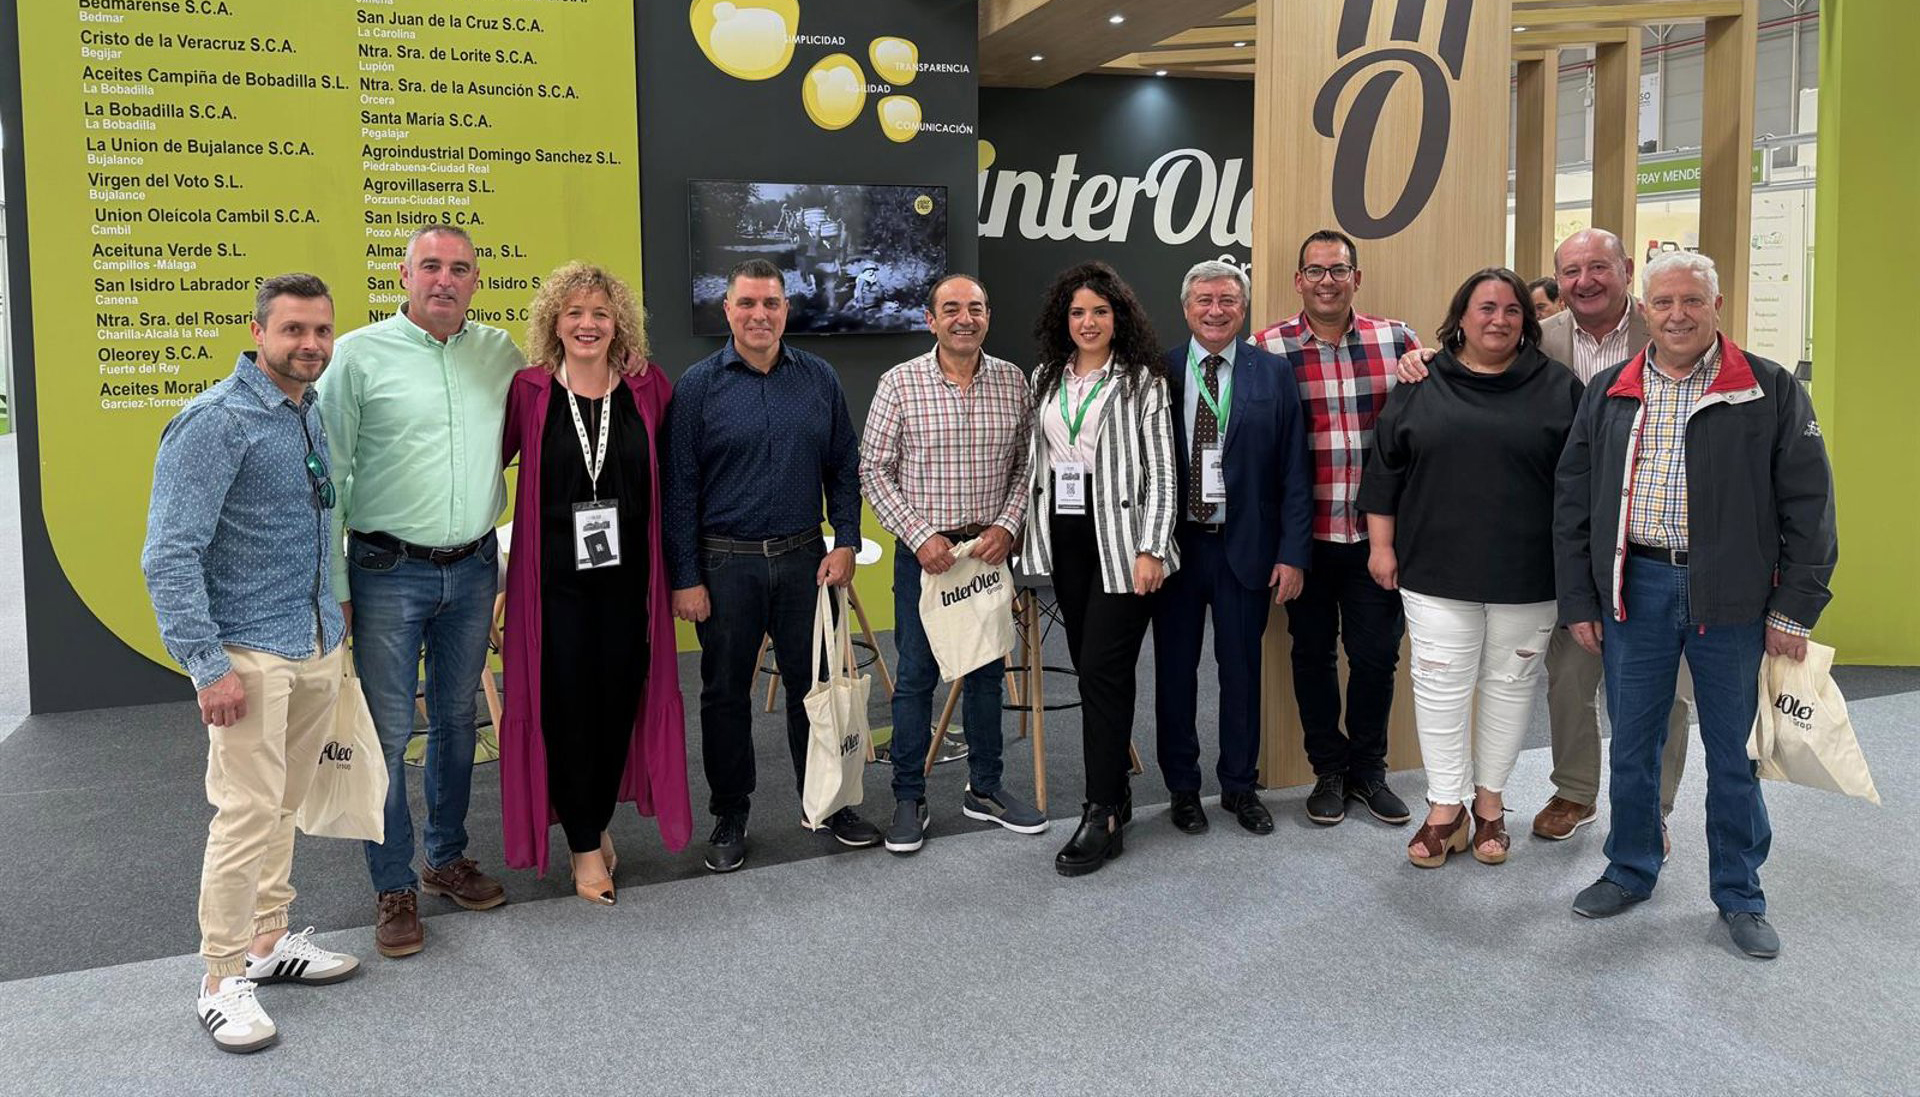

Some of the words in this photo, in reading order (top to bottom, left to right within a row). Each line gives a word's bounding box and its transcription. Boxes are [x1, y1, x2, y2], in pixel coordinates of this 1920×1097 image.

[80, 0, 179, 12] Bedmarense
[186, 0, 232, 15] S.C.A.
[79, 12, 124, 23] Bedmar
[357, 10, 384, 23] San
[389, 12, 423, 25] Juan
[429, 14, 444, 26] de
[450, 15, 461, 27] la
[467, 16, 498, 29] Cruz
[503, 18, 543, 32] S.C.A.
[358, 27, 370, 37] La
[373, 28, 416, 39] Carolina
[81, 30, 129, 45] Cristo
[135, 33, 153, 46] de
[160, 34, 172, 47] la
[177, 35, 245, 50] Veracruz
[251, 38, 296, 53] S.C.A.
[784, 35, 846, 46] SIMPLICIDAD
[359, 44, 391, 57] Ntra.
[397, 45, 424, 59] Sra.
[430, 47, 445, 60] de
[451, 48, 491, 62] Lorite
[496, 50, 536, 64] S.C.A.
[895, 62, 970, 73] TRANSPARENCIA
[83, 66, 142, 81] Aceites
[148, 69, 217, 86] Campiña
[223, 72, 240, 85] de
[246, 72, 316, 88] Bobadilla
[322, 76, 348, 89] S.L.
[83, 83, 97, 94] La
[100, 83, 154, 96] Bobadilla
[361, 78, 393, 90] Ntra.
[399, 79, 425, 92] Sra.
[431, 80, 447, 93] de
[453, 81, 463, 94] la
[468, 82, 533, 96] Asunción
[539, 85, 578, 98] S.C.A.
[845, 83, 892, 93] AGILIDAD
[360, 94, 395, 105] Orcera
[85, 102, 103, 115] La
[110, 103, 183, 118] Bobadilla
[190, 105, 236, 119] S.C.A.
[85, 119, 99, 129] La
[102, 119, 156, 131] Bobadilla
[361, 111, 401, 124] Santa
[407, 112, 444, 126] María
[450, 114, 491, 127] S.C.A.
[361, 127, 409, 140] Pegalajar
[895, 120, 974, 134] COMUNICACIÓN
[87, 137, 105, 151] La
[112, 138, 157, 152] Union
[164, 139, 182, 152] de
[188, 140, 263, 156] Bujalance
[269, 142, 313, 155] S.C.A.
[87, 154, 144, 167] Bujalance
[362, 145, 463, 160] Agroindustrial
[469, 147, 530, 164] Domingo
[536, 149, 592, 163] Sanchez
[597, 152, 620, 164] S.L.
[363, 161, 465, 174] Piedrabuena-Ciudad
[468, 164, 489, 174] Real
[88, 173, 139, 190] Virgen
[146, 174, 168, 187] del
[174, 174, 209, 187] Voto
[215, 175, 242, 188] S.L.
[1637, 172, 1661, 185] FRAY
[1663, 167, 1701, 182] MENDE
[364, 178, 463, 194] Agrovillaserra
[469, 180, 494, 192] S.L.
[89, 190, 145, 201] Bujalance
[364, 195, 445, 205] Porzuna-Ciudad
[448, 196, 470, 205] Real
[96, 208, 142, 221] Union
[148, 209, 211, 222] Oleícola
[217, 209, 269, 222] Cambil
[275, 209, 319, 222] S.C.A.
[365, 211, 391, 223] San
[397, 211, 437, 224] Isidro
[91, 225, 131, 235] Cambil
[366, 227, 391, 238] Pozo
[93, 244, 162, 256] Aceituna
[168, 244, 211, 256] Verde
[218, 243, 245, 256] S.L.
[501, 245, 526, 257] S.L.
[93, 260, 150, 273] Campillos
[95, 278, 124, 292] San
[131, 278, 174, 291] Isidro
[181, 278, 249, 291] Labrador
[368, 277, 394, 289] San
[489, 277, 527, 289] Isidro
[95, 295, 138, 306] Canena
[97, 314, 133, 326] Ntra.
[140, 313, 169, 326] Sra.
[176, 312, 198, 325] del
[464, 309, 501, 322] Olivo
[97, 329, 179, 340] Charilla-Alcalá
[182, 328, 192, 339] la
[195, 328, 219, 338] Real
[99, 348, 159, 363] Oleorey
[166, 346, 212, 359] S.C.A.
[100, 364, 135, 375] Fuerte
[138, 363, 156, 375] del
[159, 363, 180, 375] Rey
[101, 382, 158, 396] Aceites
[165, 380, 207, 394] Moral
